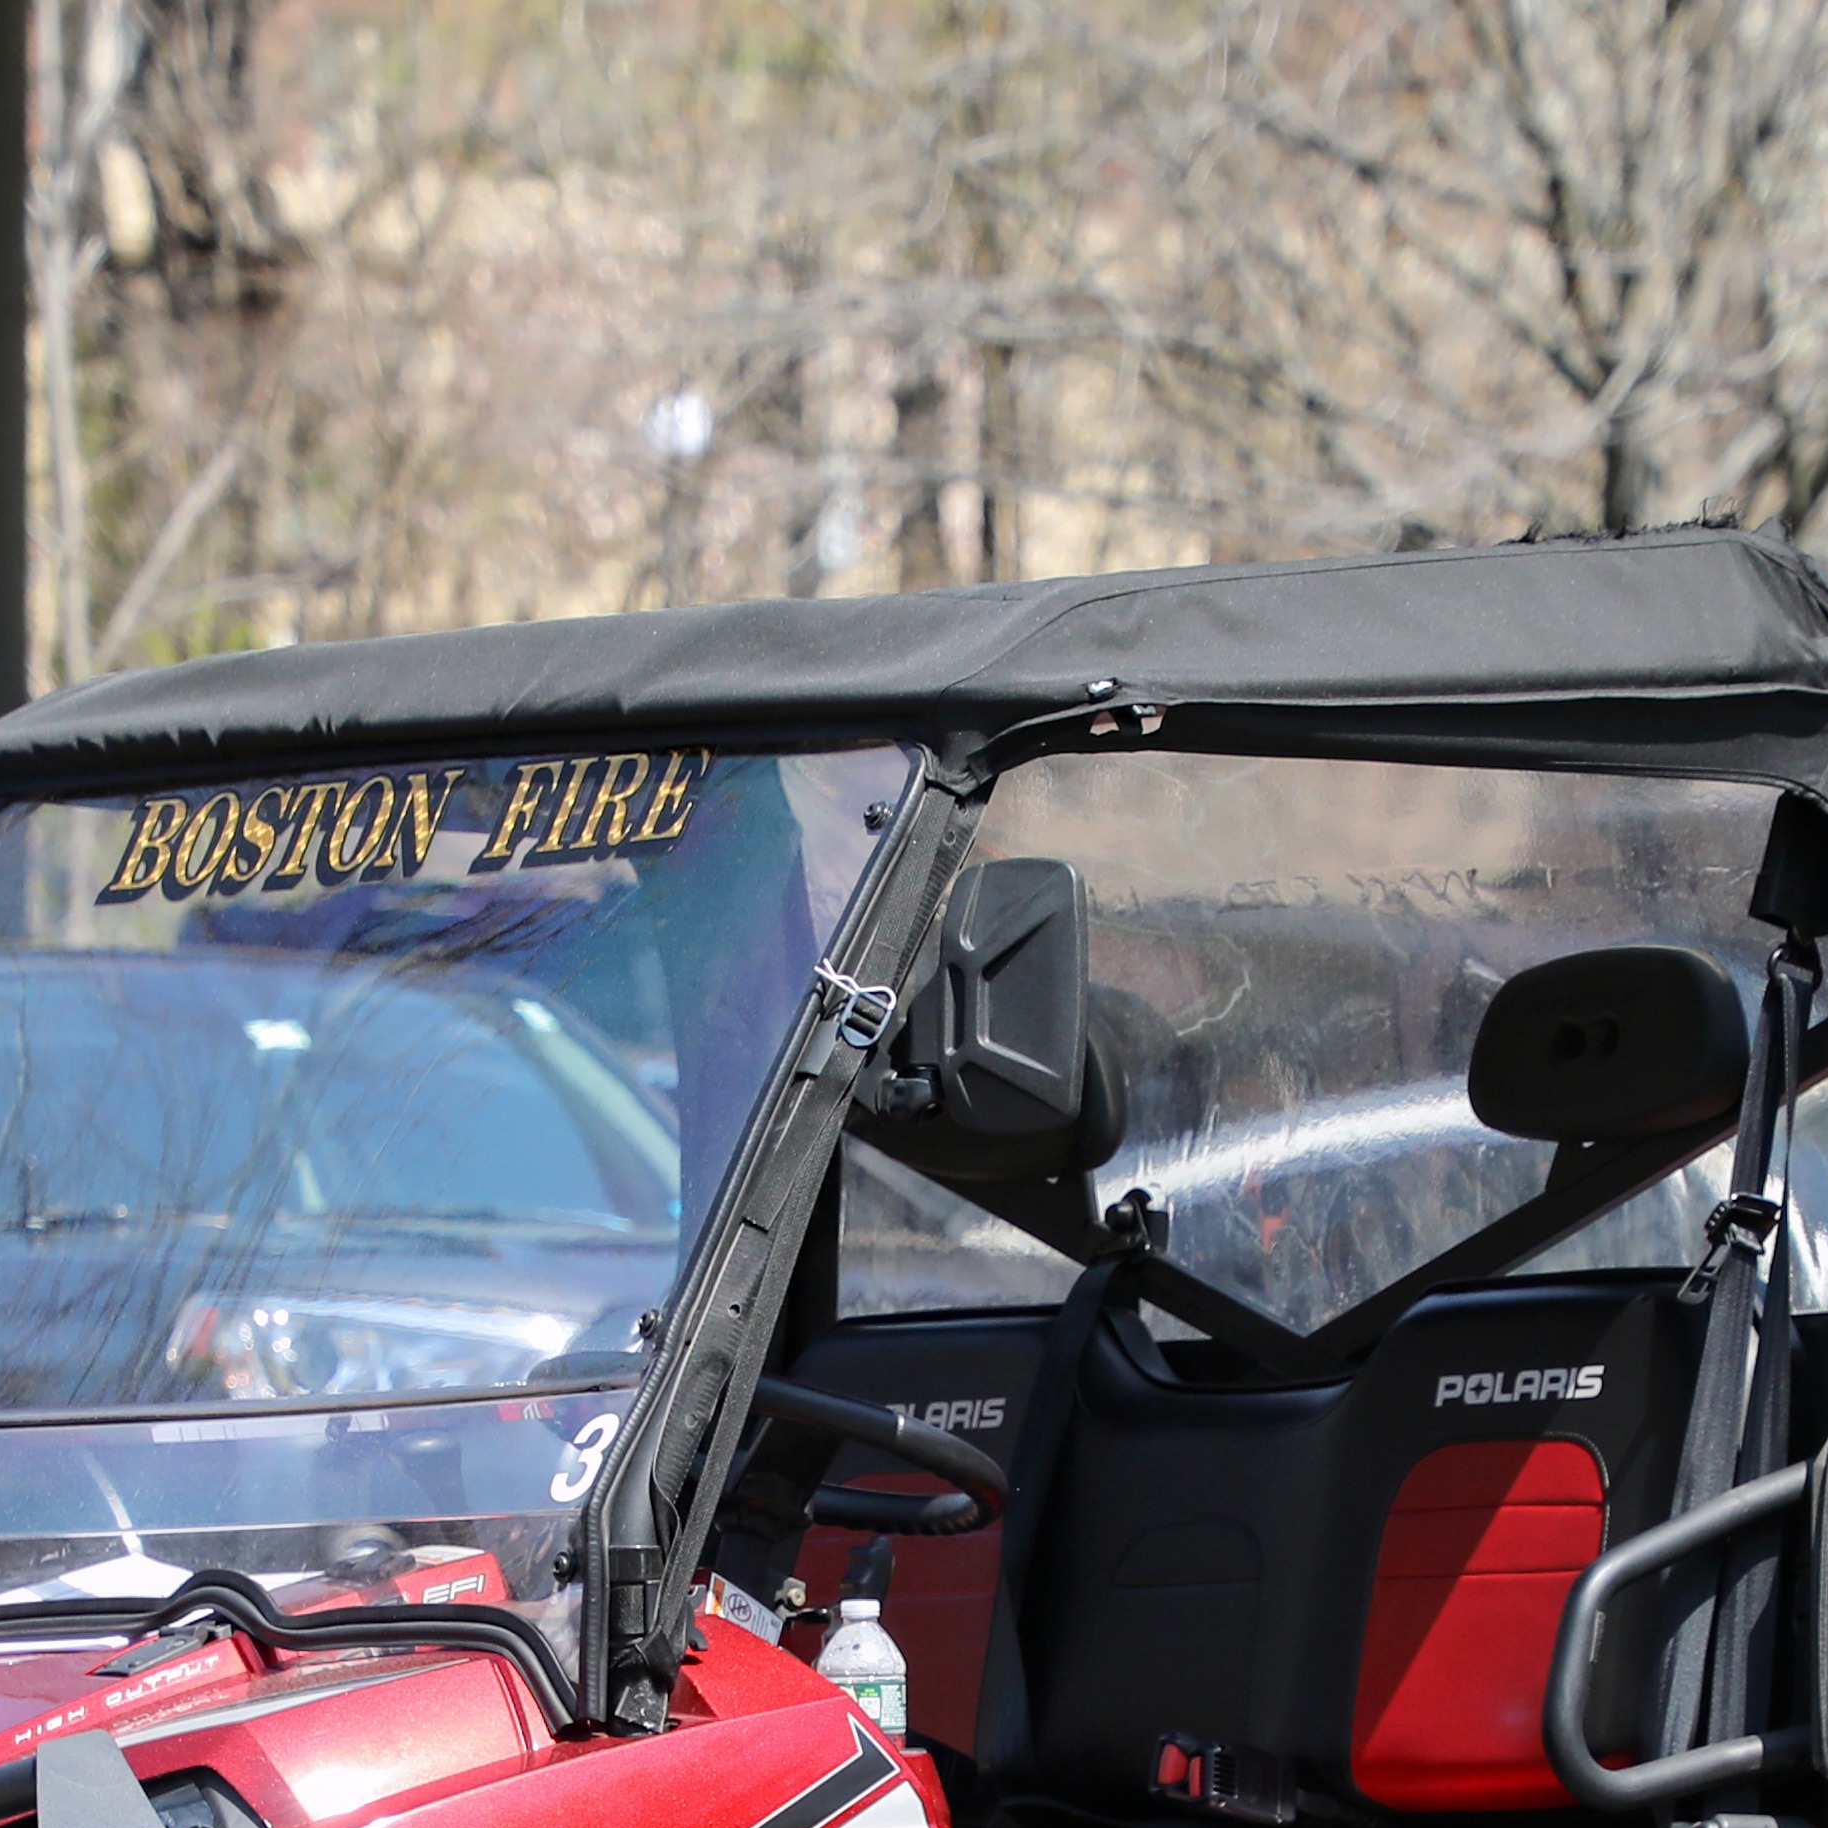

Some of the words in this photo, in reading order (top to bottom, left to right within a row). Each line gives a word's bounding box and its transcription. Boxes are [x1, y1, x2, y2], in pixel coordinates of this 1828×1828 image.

[96, 768, 465, 904] BOSTON
[469, 746, 716, 872] FIRE
[1434, 1364, 1605, 1408] POLARIS
[885, 1397, 1007, 1431] ARIS
[550, 1413, 620, 1502] 3
[422, 1573, 485, 1604] EFI
